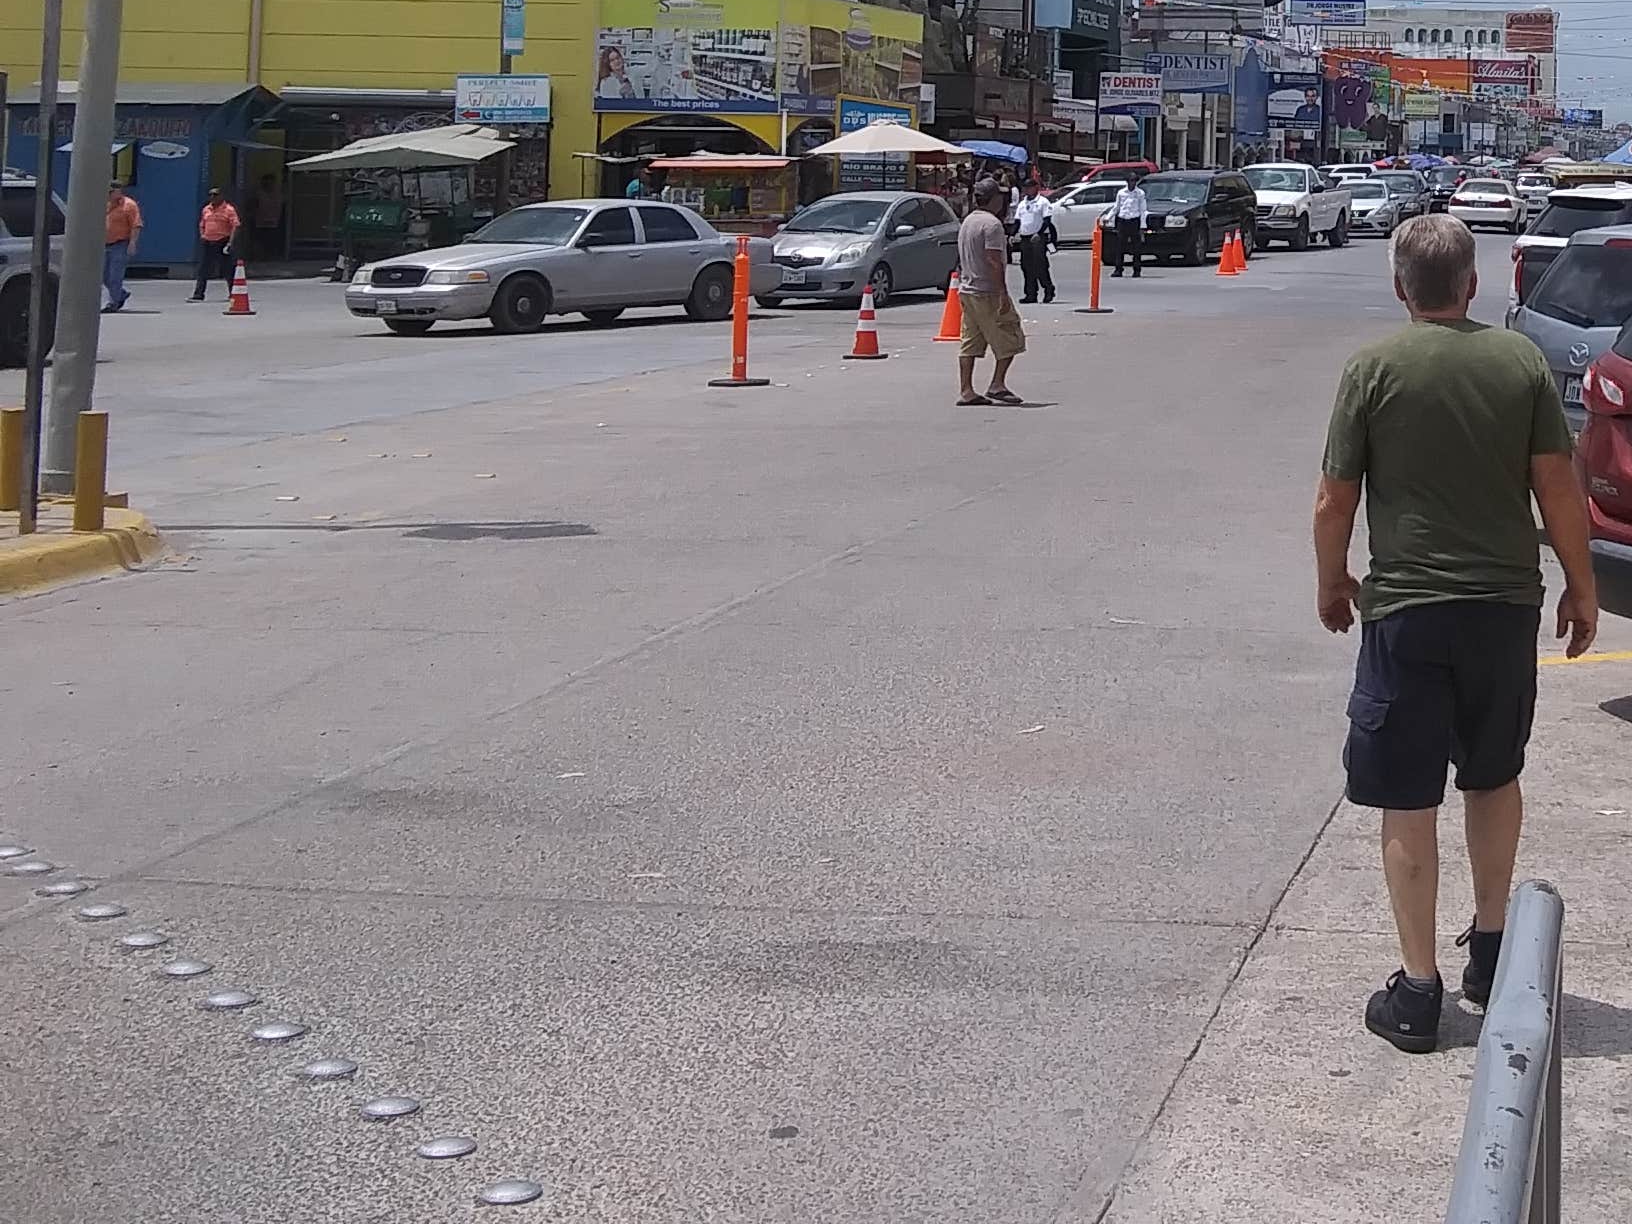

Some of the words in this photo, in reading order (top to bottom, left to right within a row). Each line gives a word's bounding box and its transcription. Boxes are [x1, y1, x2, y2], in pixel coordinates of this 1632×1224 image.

[1163, 56, 1226, 70] DENTIST
[1114, 77, 1160, 89] DENTIST
[653, 100, 669, 108] The
[671, 100, 689, 108] best
[692, 101, 720, 110] prices
